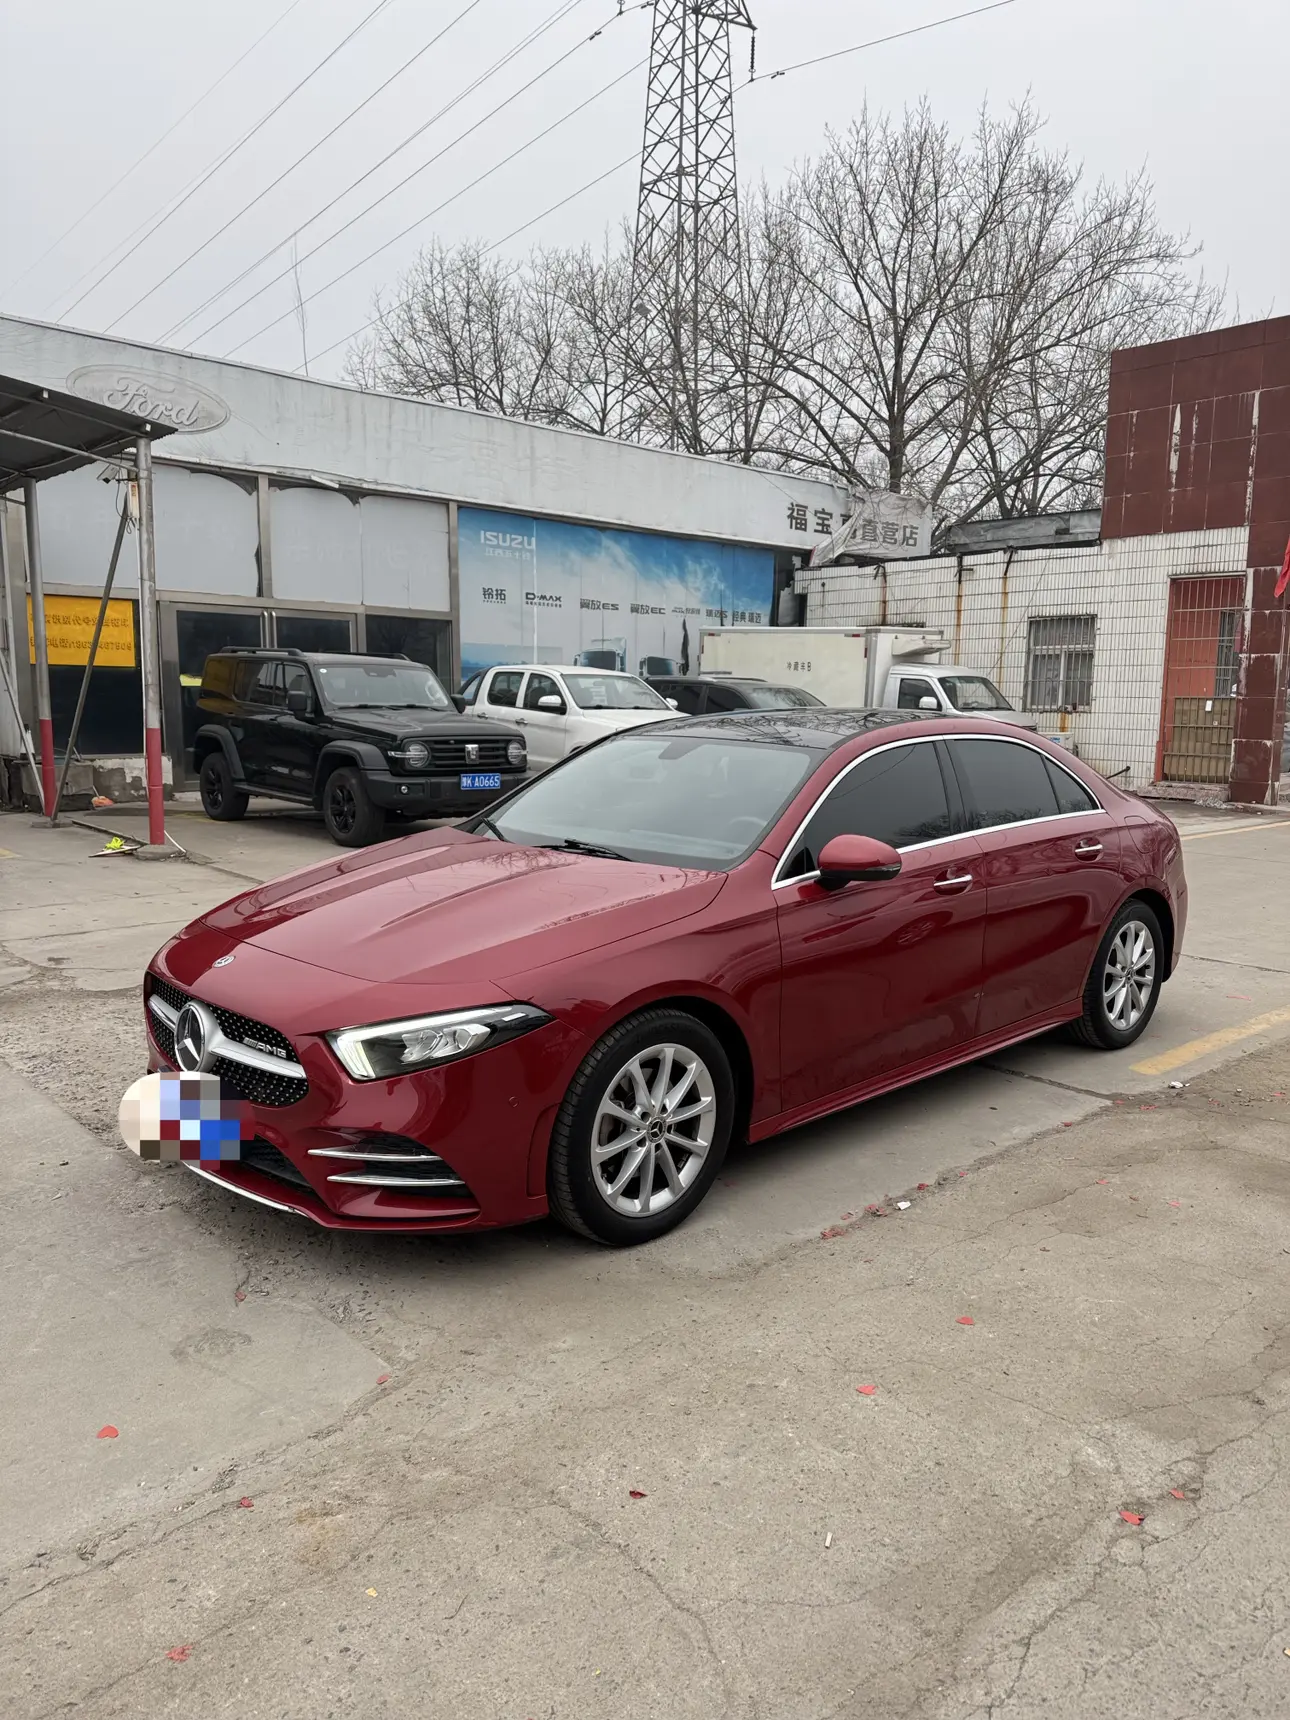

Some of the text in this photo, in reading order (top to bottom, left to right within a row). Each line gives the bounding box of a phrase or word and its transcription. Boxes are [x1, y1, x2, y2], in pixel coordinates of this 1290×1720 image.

[103, 376, 200, 426] Ford
[480, 530, 535, 549] ISUZU
[482, 587, 507, 601] 铃拓
[256, 1043, 287, 1058] AMG
